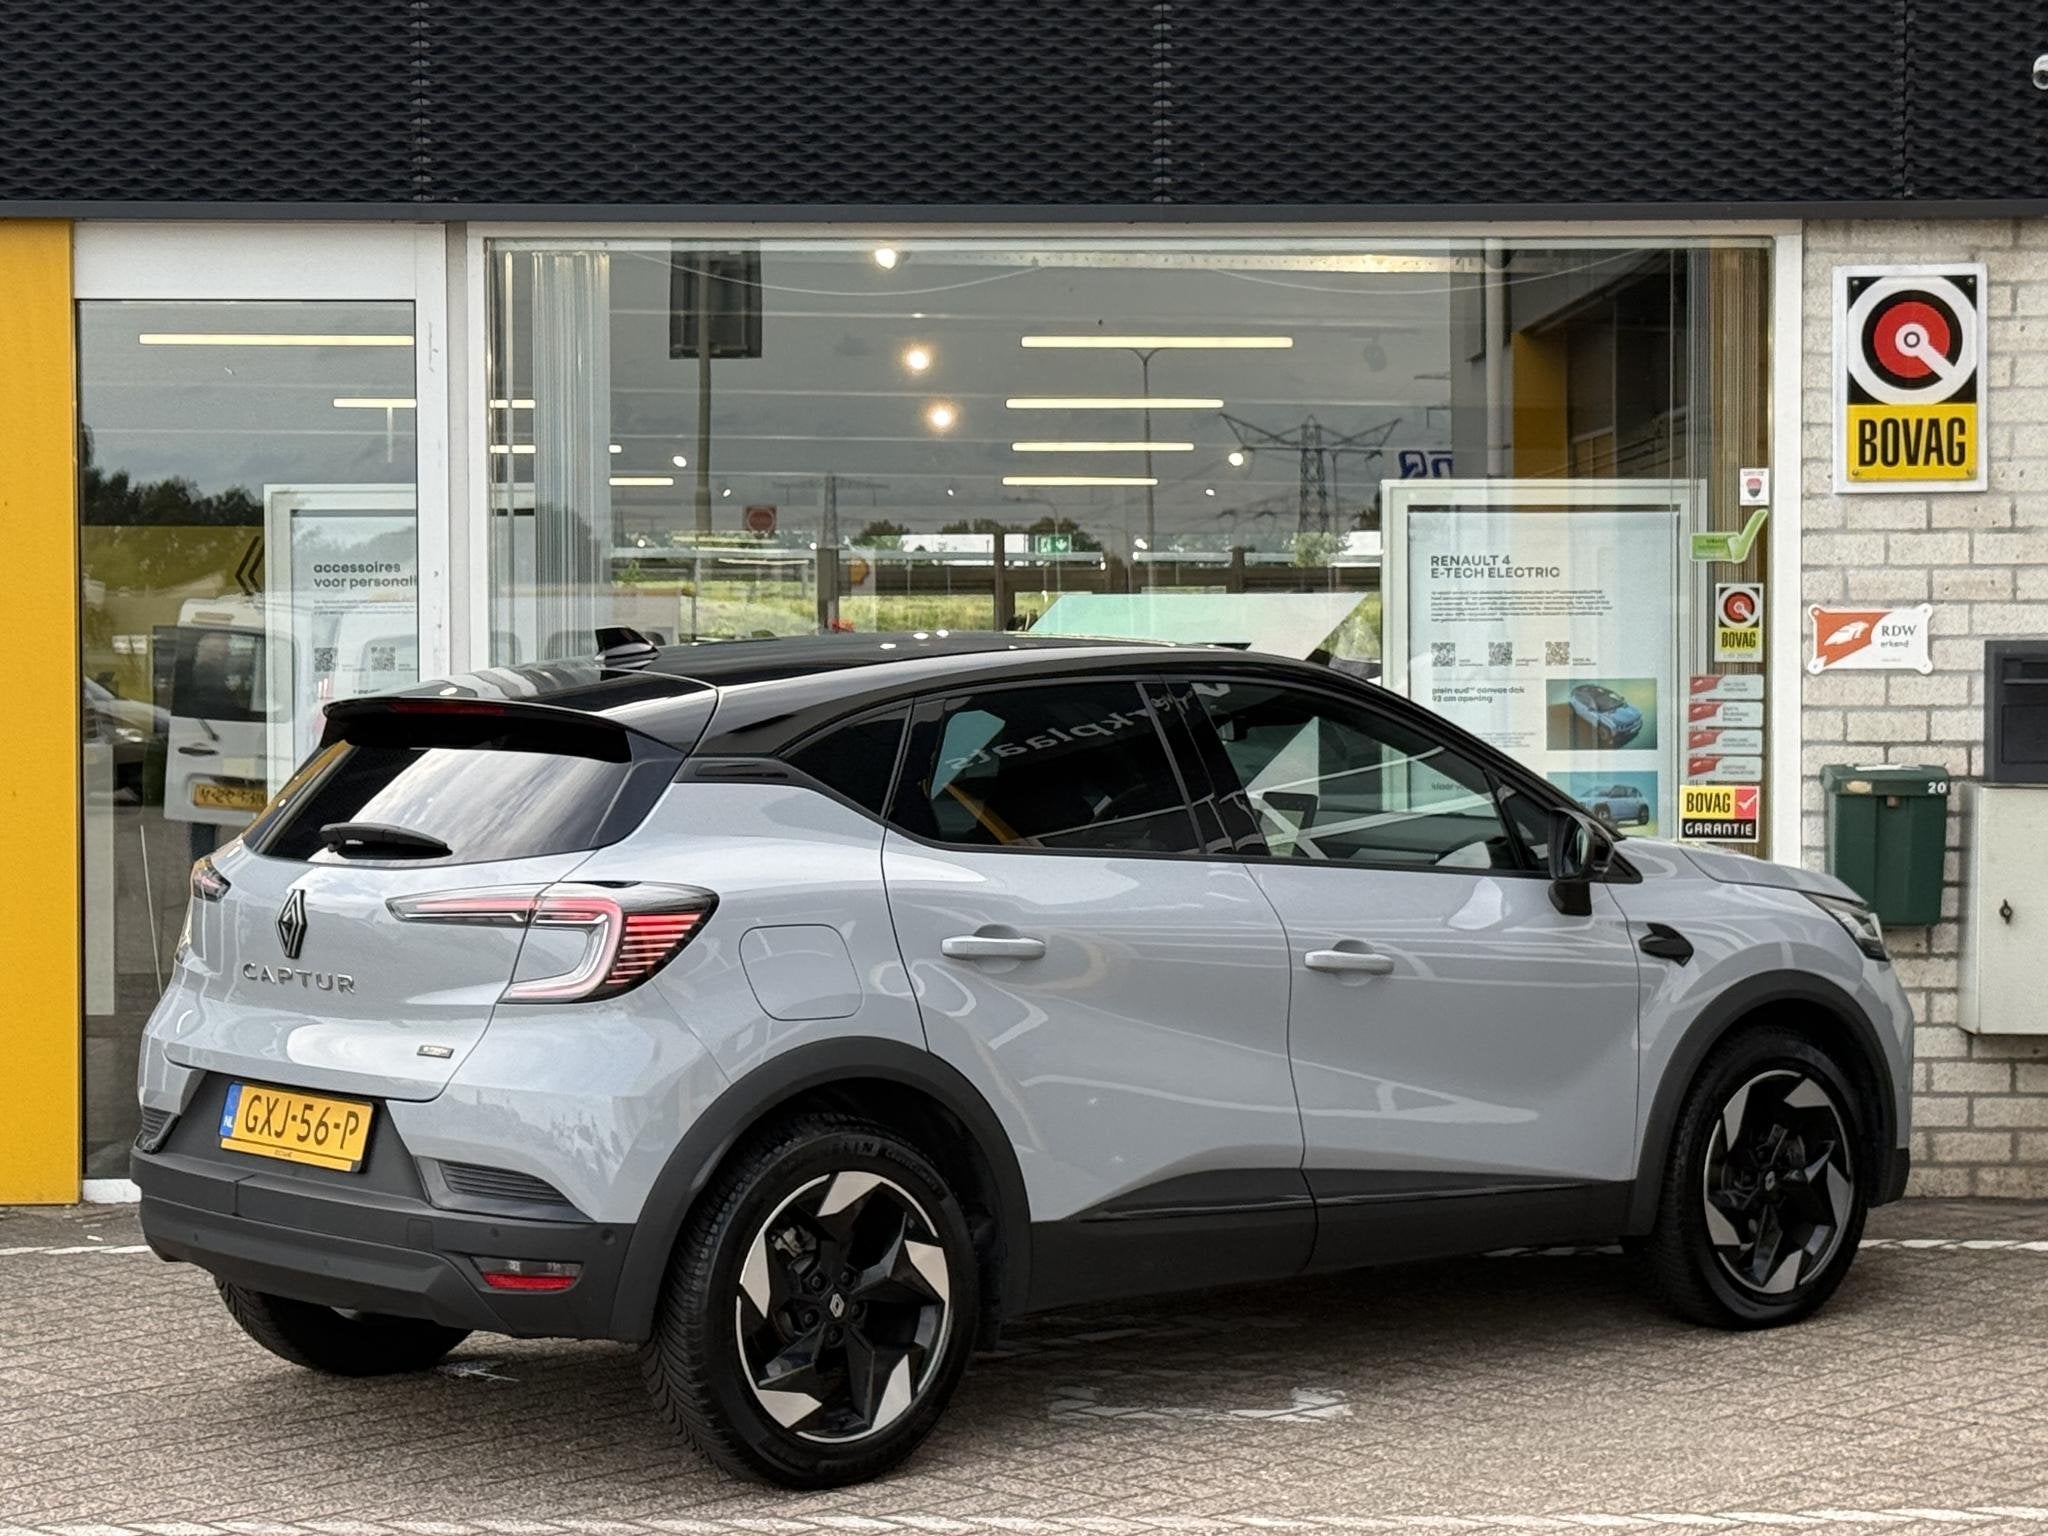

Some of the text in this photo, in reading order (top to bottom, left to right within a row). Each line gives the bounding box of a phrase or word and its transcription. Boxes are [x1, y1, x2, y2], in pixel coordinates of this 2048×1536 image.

[1858, 418, 1966, 467] BOVAG
[313, 561, 401, 573] accessoires
[1431, 555, 1511, 567] RENAULT 4
[1431, 567, 1560, 579] E-TECH ELECTRIC
[313, 577, 346, 588] voor
[1882, 625, 1916, 636] RDW
[1721, 631, 1757, 648] BOVAG
[1928, 782, 1947, 794] 20
[1687, 793, 1731, 813] BOVAG
[1685, 822, 1753, 836] GARANTIE
[243, 963, 356, 994] CAPTUR
[223, 1114, 234, 1128] NL
[245, 1094, 359, 1150] GXJ-56-P
